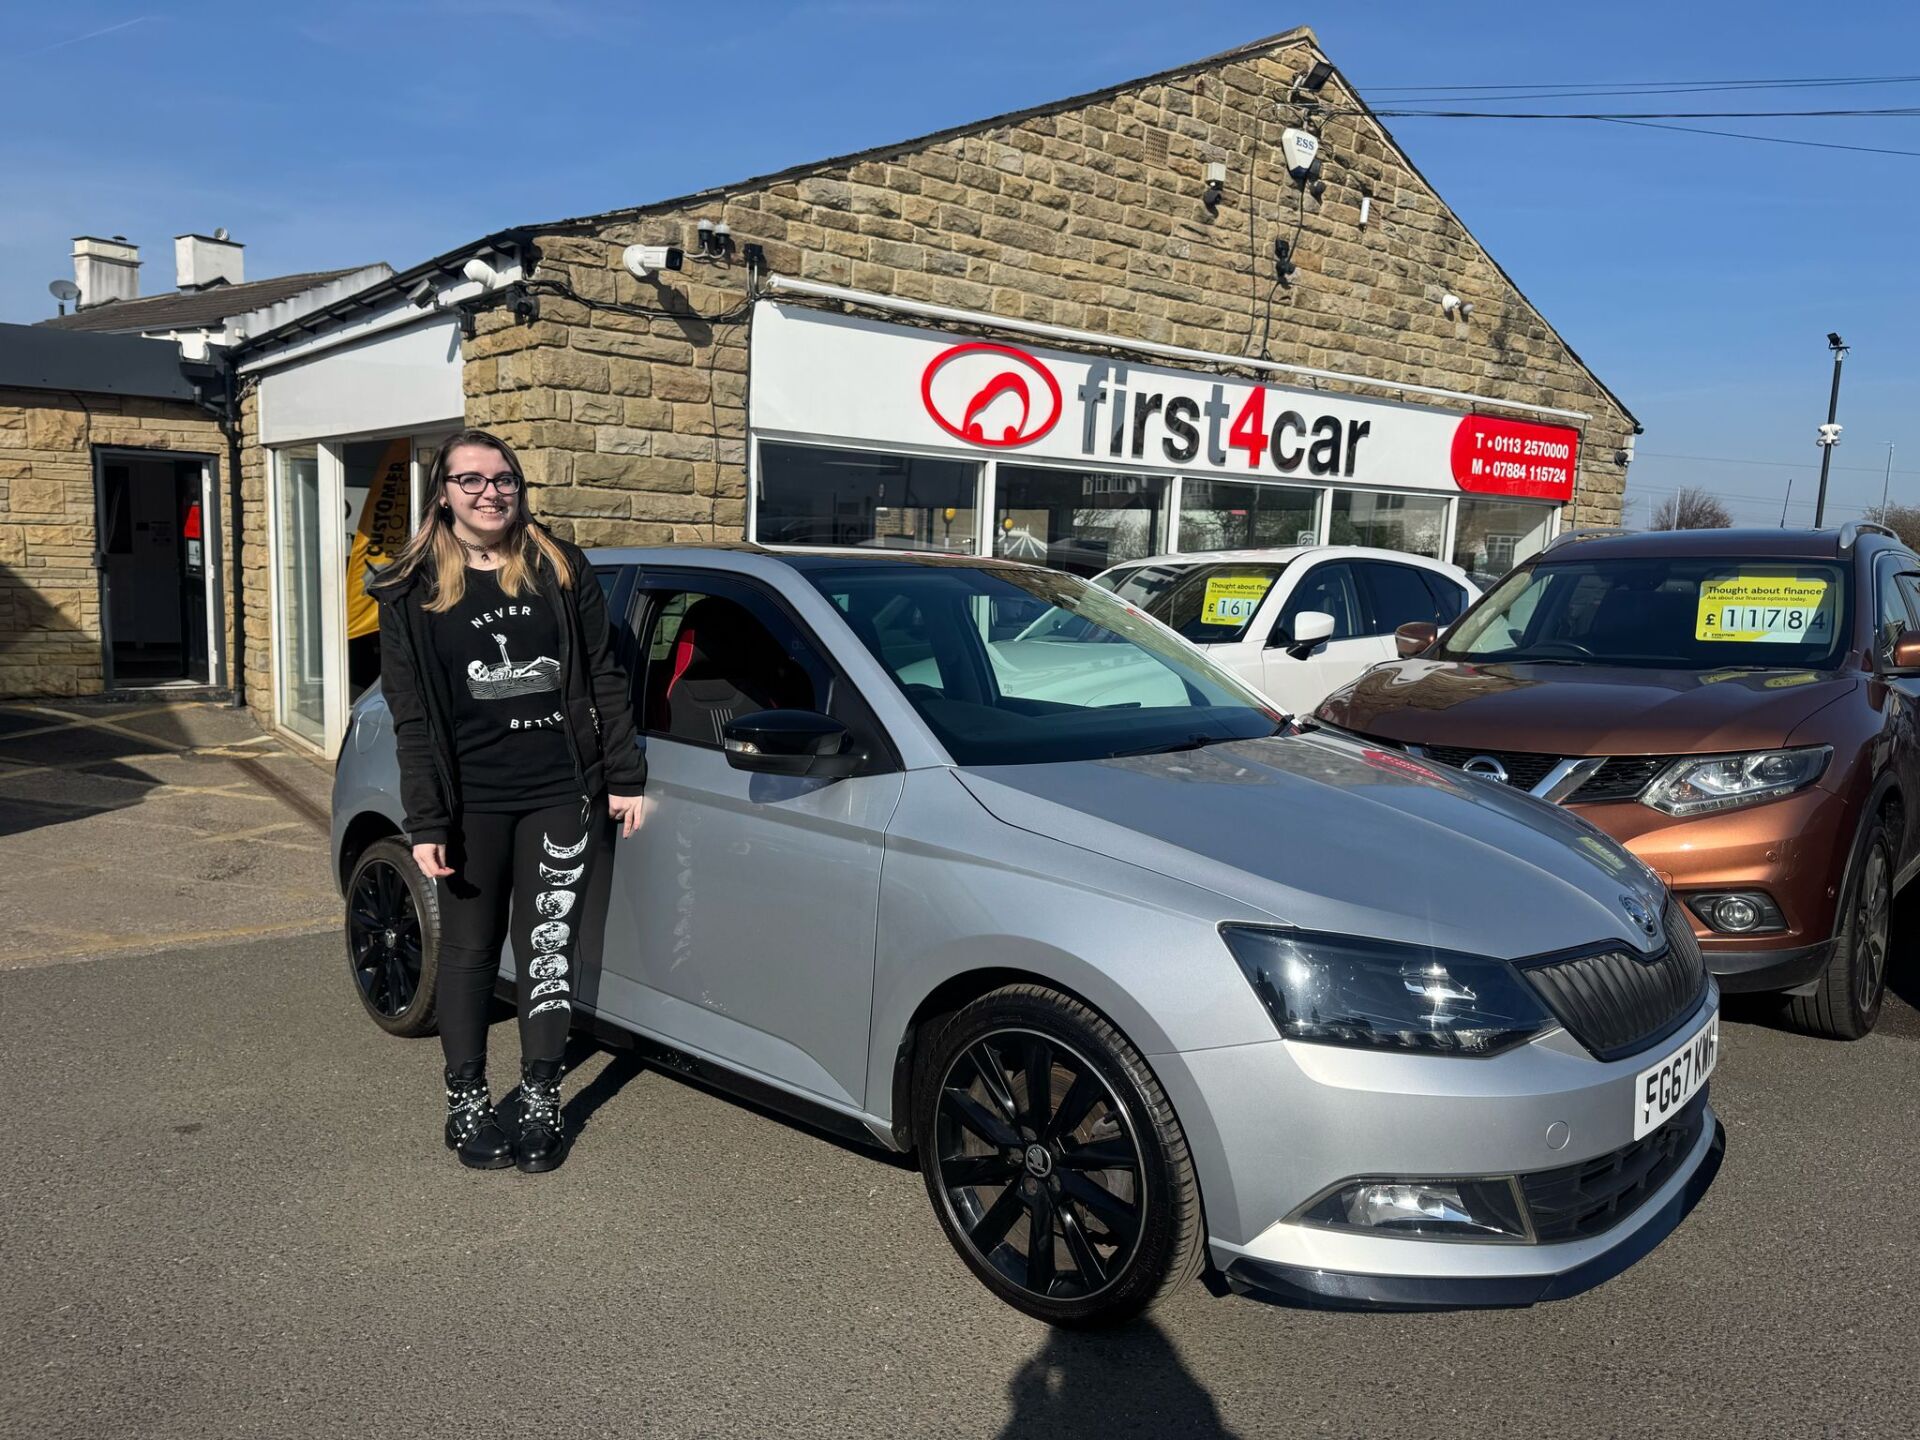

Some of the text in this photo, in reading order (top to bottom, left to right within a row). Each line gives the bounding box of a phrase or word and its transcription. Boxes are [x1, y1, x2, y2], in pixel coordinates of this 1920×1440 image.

[1296, 136, 1314, 150] ESS
[1078, 357, 1371, 478] first4car
[1494, 435, 1522, 454] 0113
[1524, 439, 1569, 459] 2570000
[1492, 461, 1526, 479] 07884
[1529, 465, 1566, 483] 115724
[366, 462, 406, 557] CUSTOMER
[1211, 582, 1236, 590] Thought
[1708, 586, 1748, 595] Thought
[1751, 587, 1780, 595] about
[471, 606, 531, 628] NEVER
[1208, 603, 1215, 612] £
[1705, 609, 1826, 630] £ 11784
[510, 711, 564, 729] BETTE
[1645, 1047, 1691, 1125] FG67
